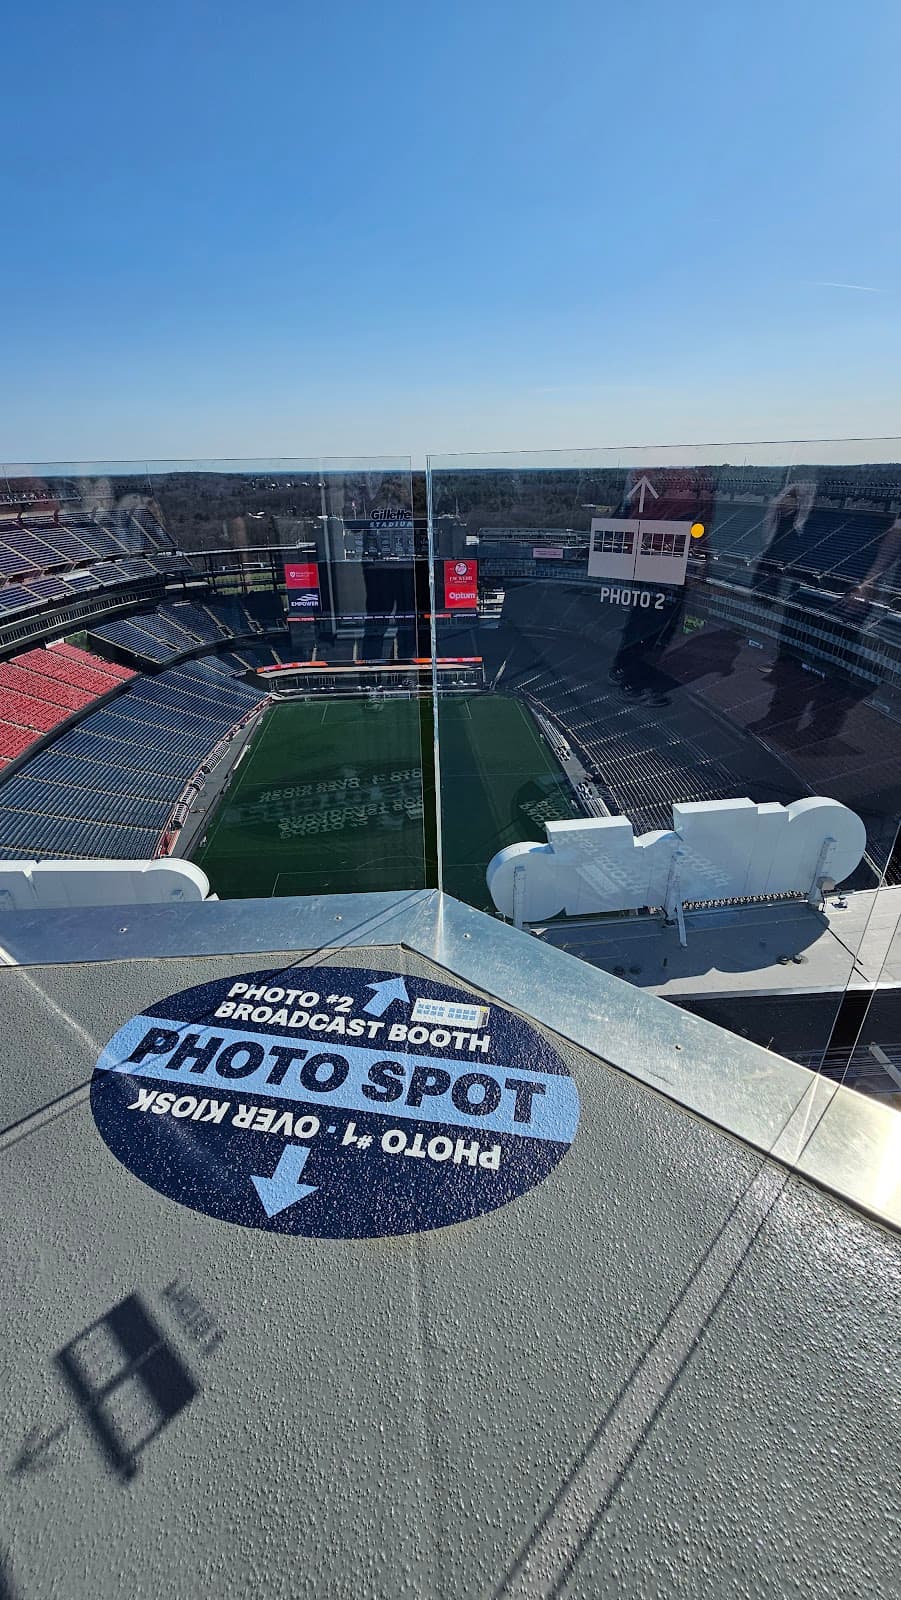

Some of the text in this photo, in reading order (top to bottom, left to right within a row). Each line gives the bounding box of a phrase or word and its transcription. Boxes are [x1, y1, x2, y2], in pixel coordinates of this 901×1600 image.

[370, 509, 412, 520] Gillette
[449, 592, 476, 600] Optum
[600, 587, 666, 609] PHOTO 2
[227, 982, 354, 1013] PHOTO #2
[214, 1001, 491, 1053] BROADCAST BOOTH
[127, 1027, 546, 1124] PHOTO SPOT
[127, 1088, 502, 1171] PHOTO #1 OVER KIOSK
